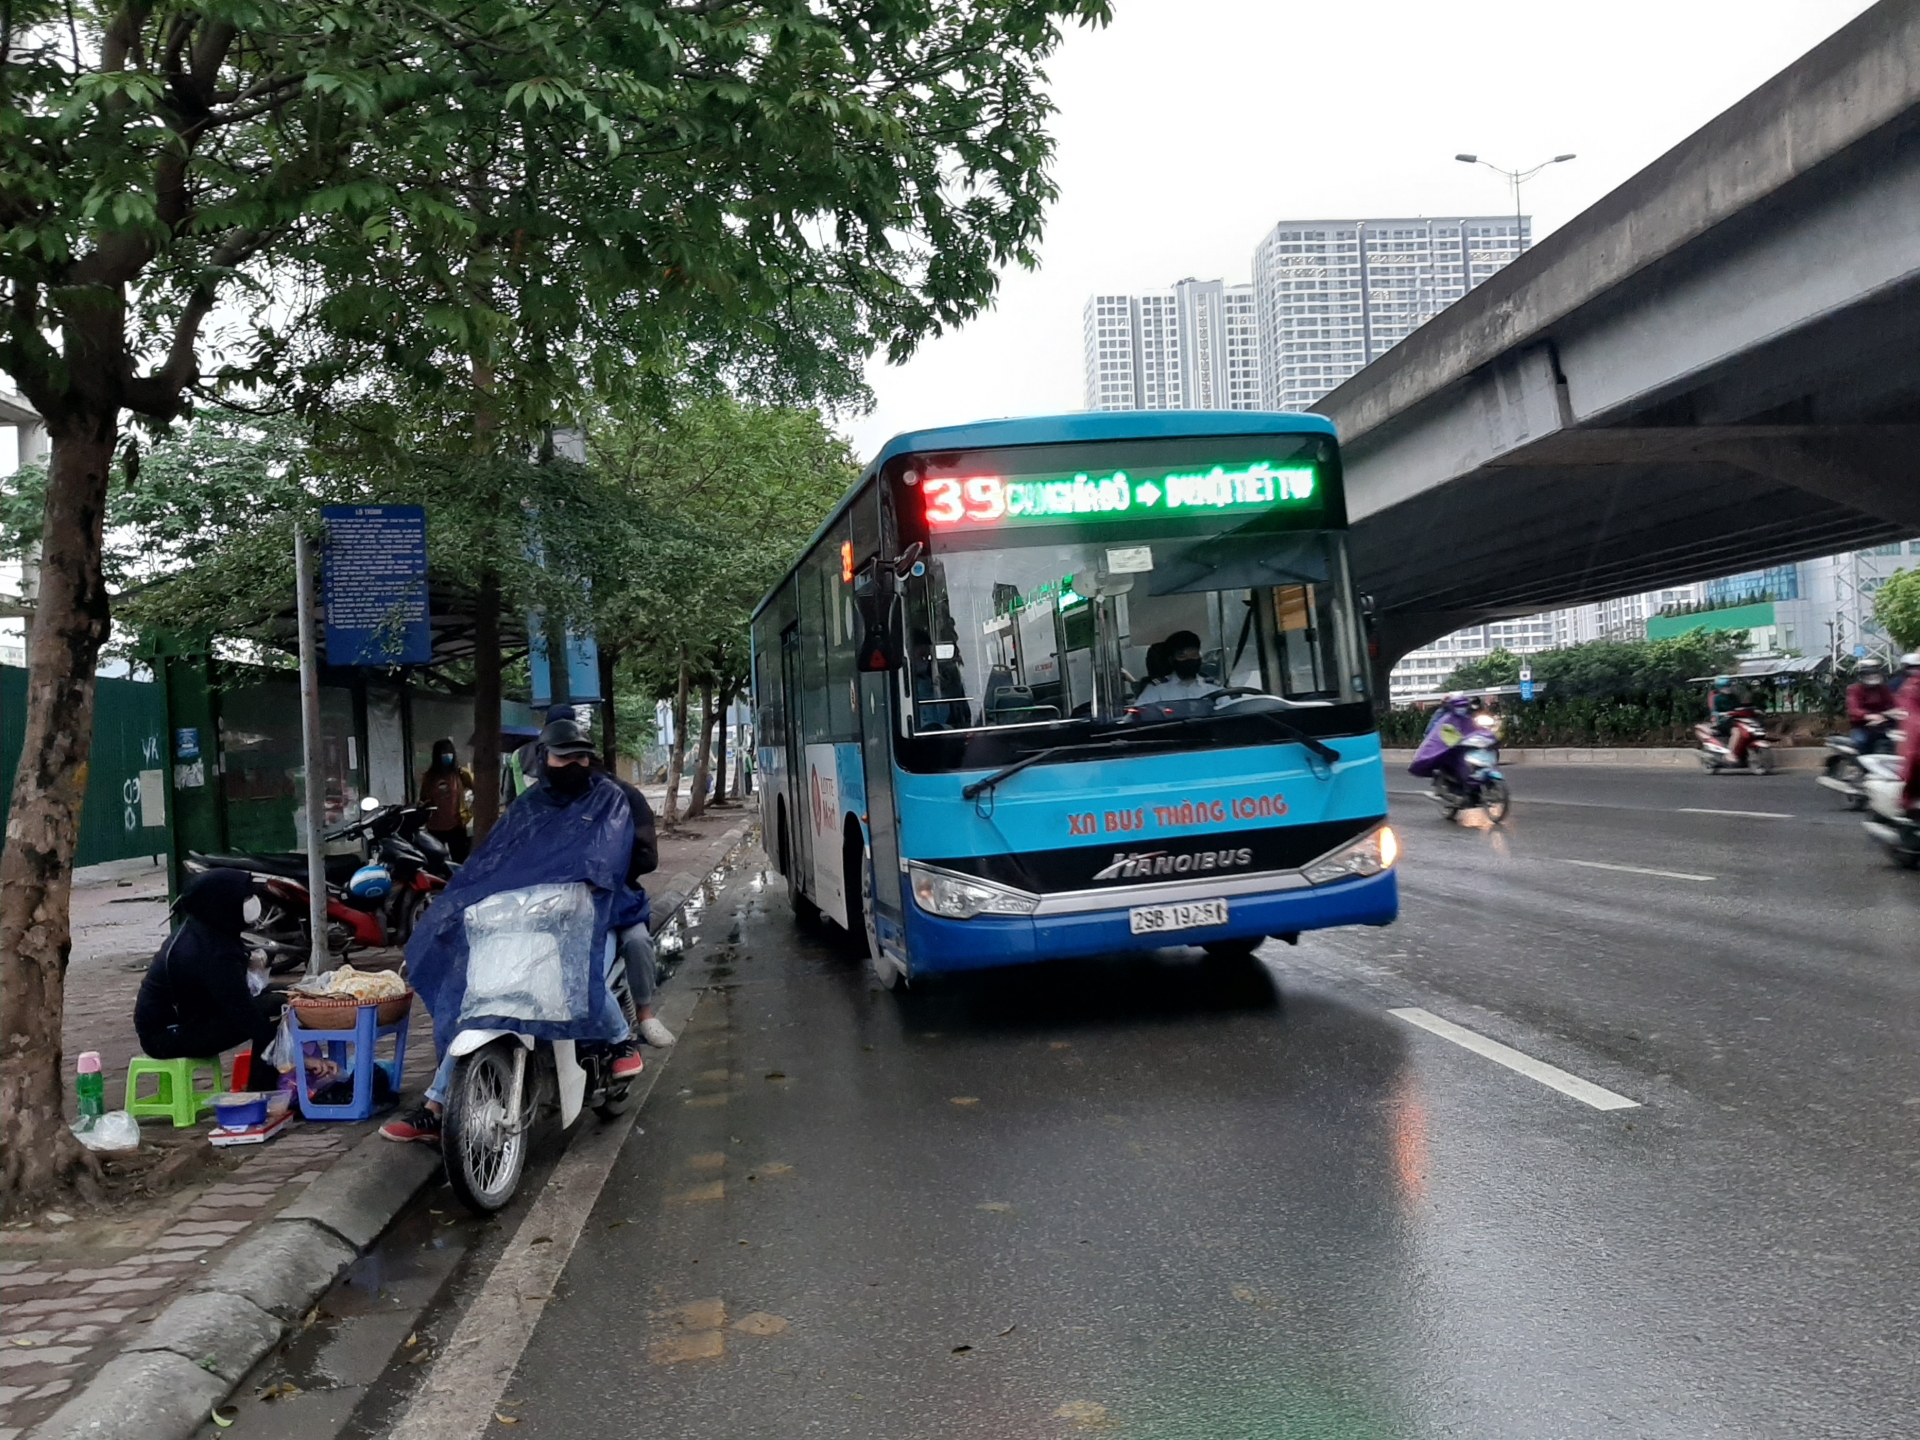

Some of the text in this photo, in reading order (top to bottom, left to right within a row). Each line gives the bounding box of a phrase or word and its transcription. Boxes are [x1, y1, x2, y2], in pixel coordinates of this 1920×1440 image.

[925, 478, 1005, 522] 39
[1105, 808, 1144, 832] BUS
[1232, 794, 1288, 819] LONG
[1092, 847, 1253, 881] HANOIBUS
